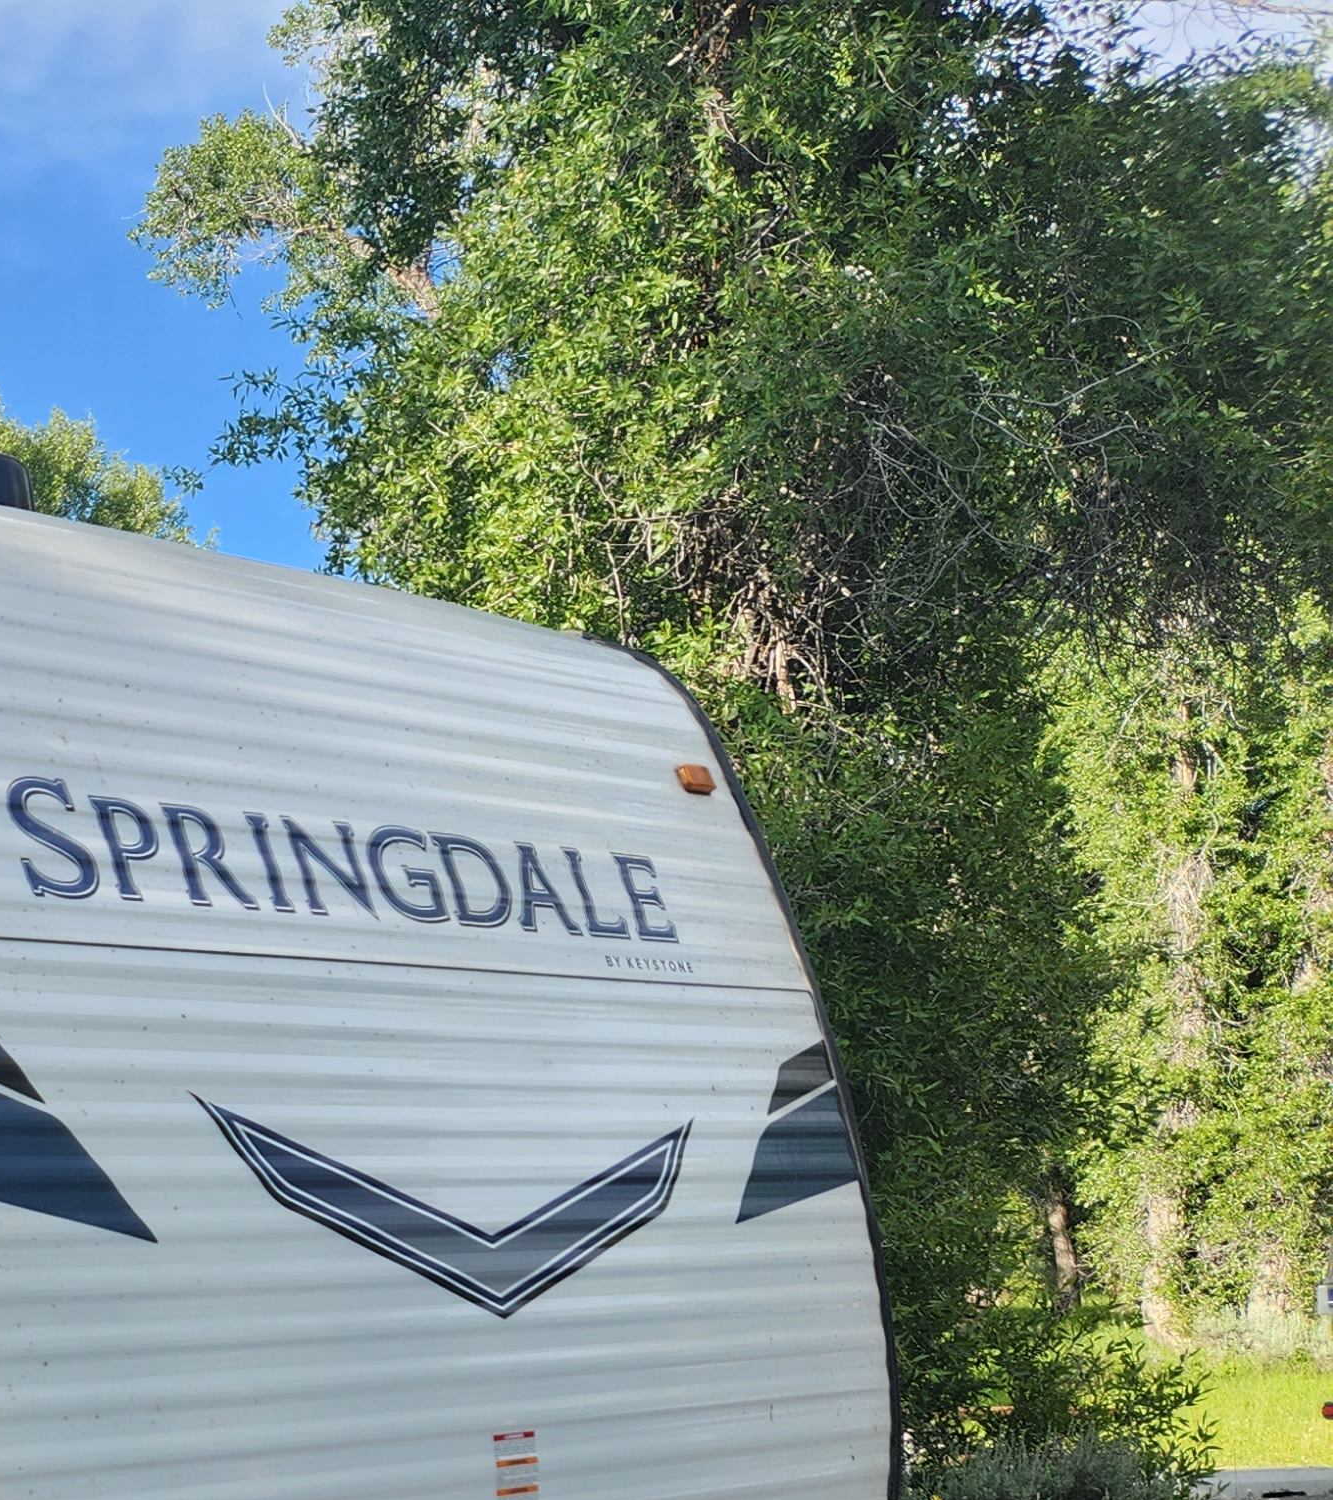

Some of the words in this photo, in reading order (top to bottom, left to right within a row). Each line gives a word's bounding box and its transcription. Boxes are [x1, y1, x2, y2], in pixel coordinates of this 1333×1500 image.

[6, 775, 680, 944] SPRINGDALE
[604, 954, 621, 968] BY
[625, 956, 694, 974] KEYSTONE
